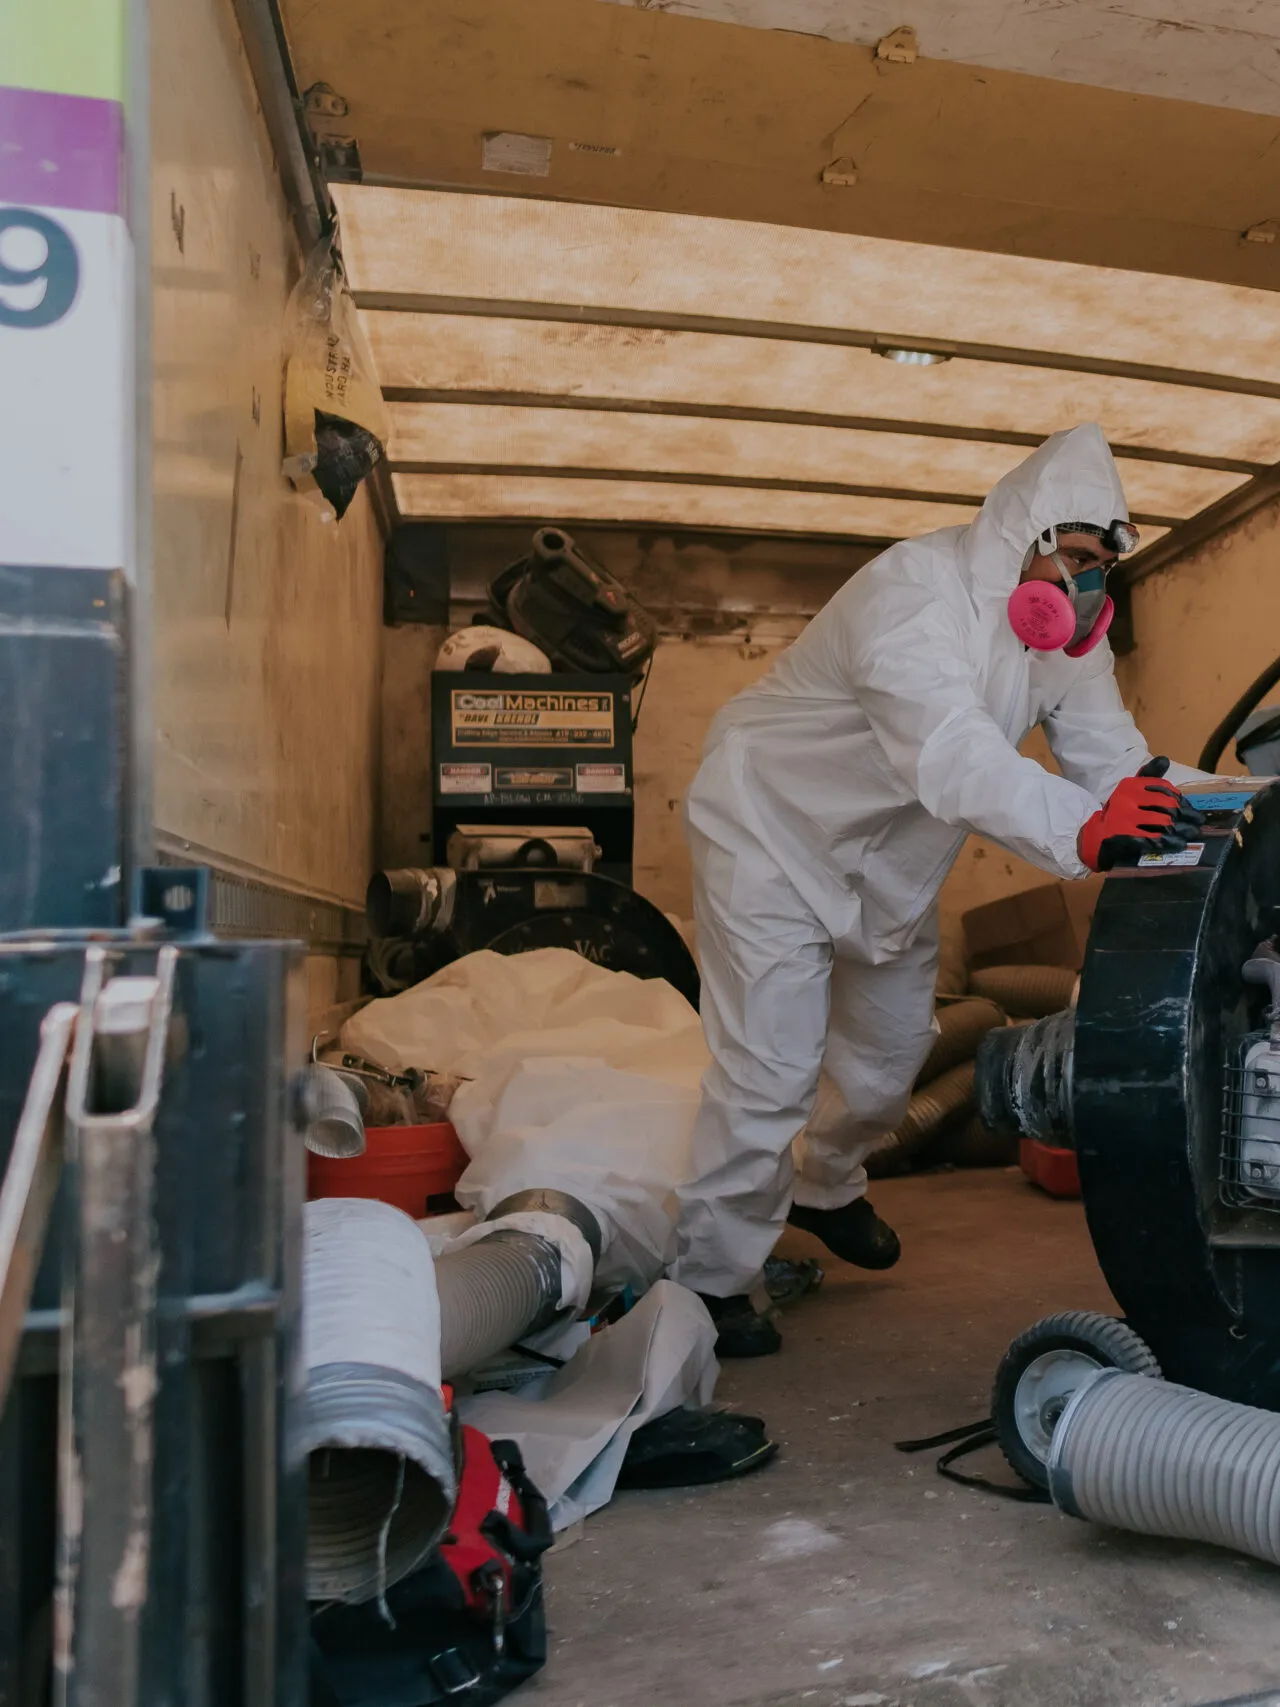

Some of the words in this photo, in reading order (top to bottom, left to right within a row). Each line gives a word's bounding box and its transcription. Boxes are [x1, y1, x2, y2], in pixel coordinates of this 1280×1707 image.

[0, 207, 79, 328] 9
[459, 694, 503, 709] Cool
[505, 695, 599, 711] Machines
